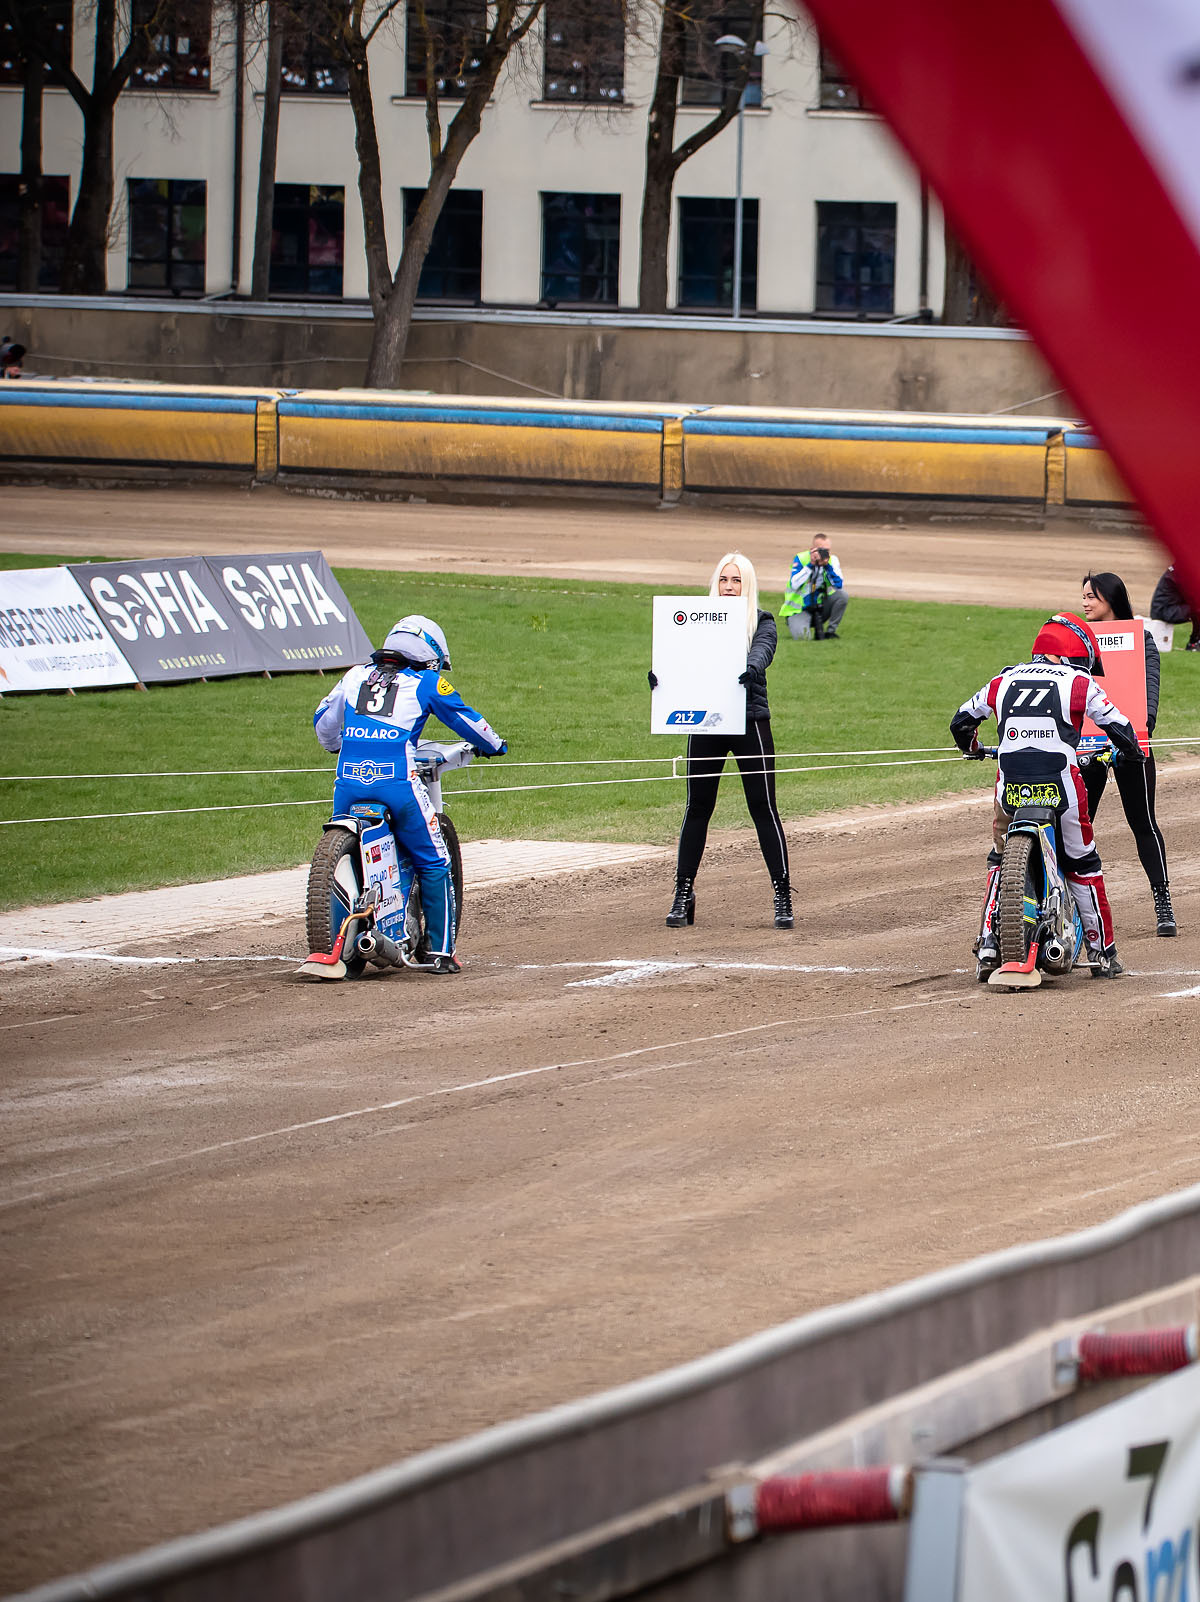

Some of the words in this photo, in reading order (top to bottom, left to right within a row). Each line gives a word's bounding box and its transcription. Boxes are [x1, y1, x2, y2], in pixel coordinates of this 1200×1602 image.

[222, 563, 346, 631] SOFIA
[90, 570, 229, 642] SOFIA
[0, 603, 103, 648] MBERSTUDIOS
[690, 612, 728, 622] OPTIBET
[1095, 635, 1123, 646] TIBET
[281, 644, 344, 661] DAUGAVPILS
[158, 653, 227, 671] DAUGAVPILS
[366, 682, 388, 713] 3
[345, 726, 400, 740] STOLARO
[1020, 729, 1055, 739] OPTIBET
[352, 766, 383, 777] REALL
